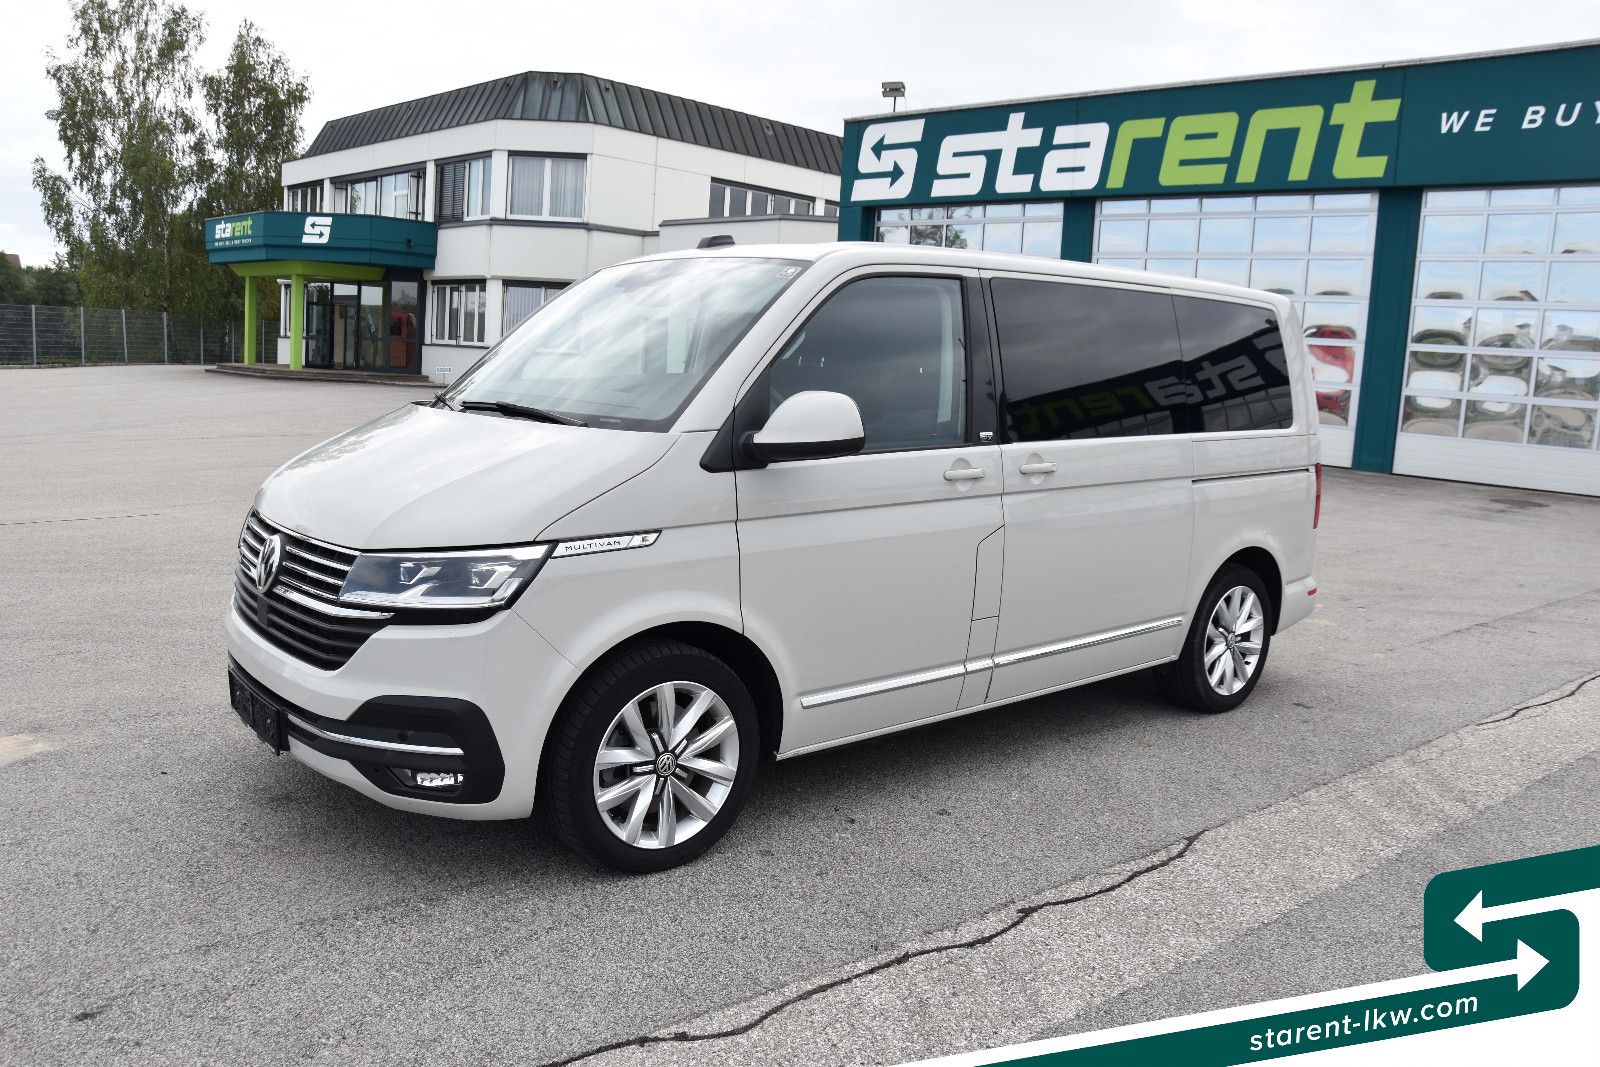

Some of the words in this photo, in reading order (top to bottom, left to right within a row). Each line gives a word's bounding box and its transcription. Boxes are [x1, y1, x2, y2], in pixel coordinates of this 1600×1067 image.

[1440, 108, 1498, 134] WE
[931, 80, 1402, 198] starent
[215, 216, 253, 239] starent
[564, 540, 622, 552] MULTIVAN
